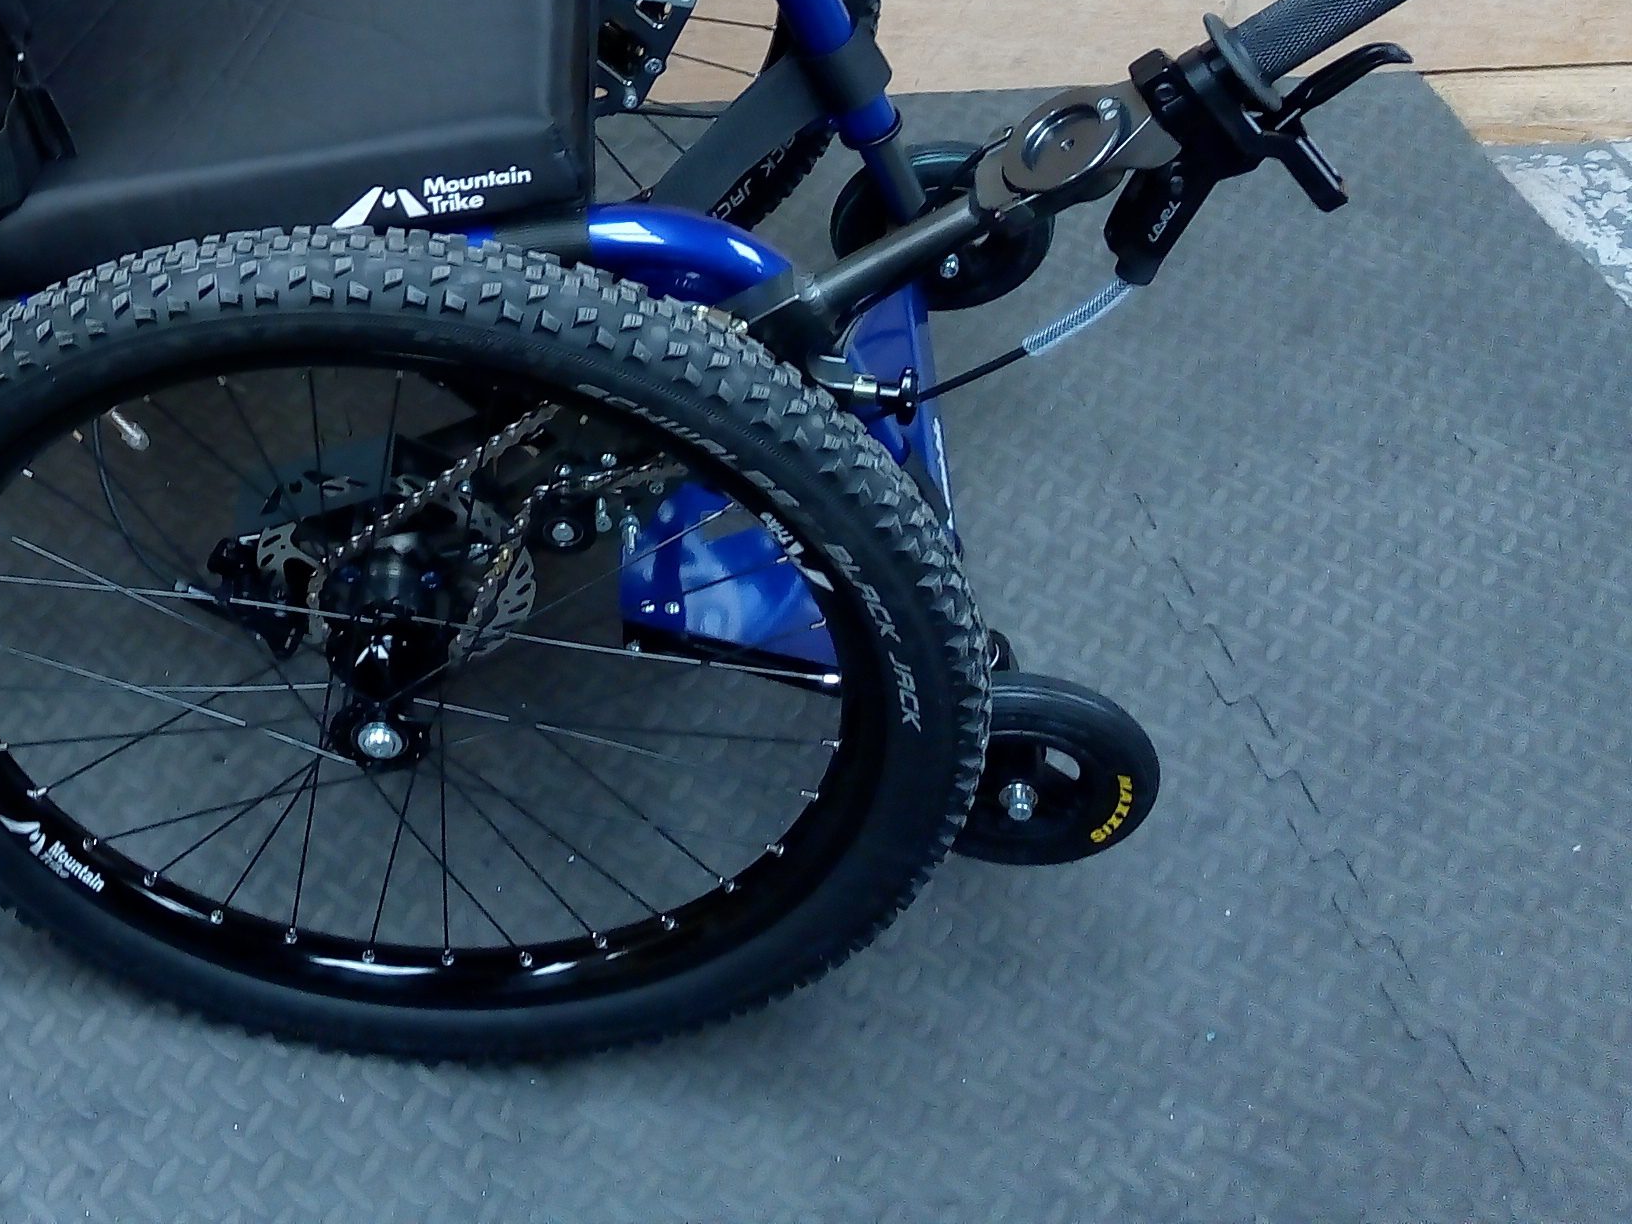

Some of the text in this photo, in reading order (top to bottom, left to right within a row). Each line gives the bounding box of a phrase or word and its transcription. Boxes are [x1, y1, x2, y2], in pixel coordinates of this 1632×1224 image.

[423, 166, 532, 197] Mountain
[426, 192, 485, 216] Trike
[824, 543, 922, 732] BLACK JACK
[49, 840, 105, 893] Mountain
